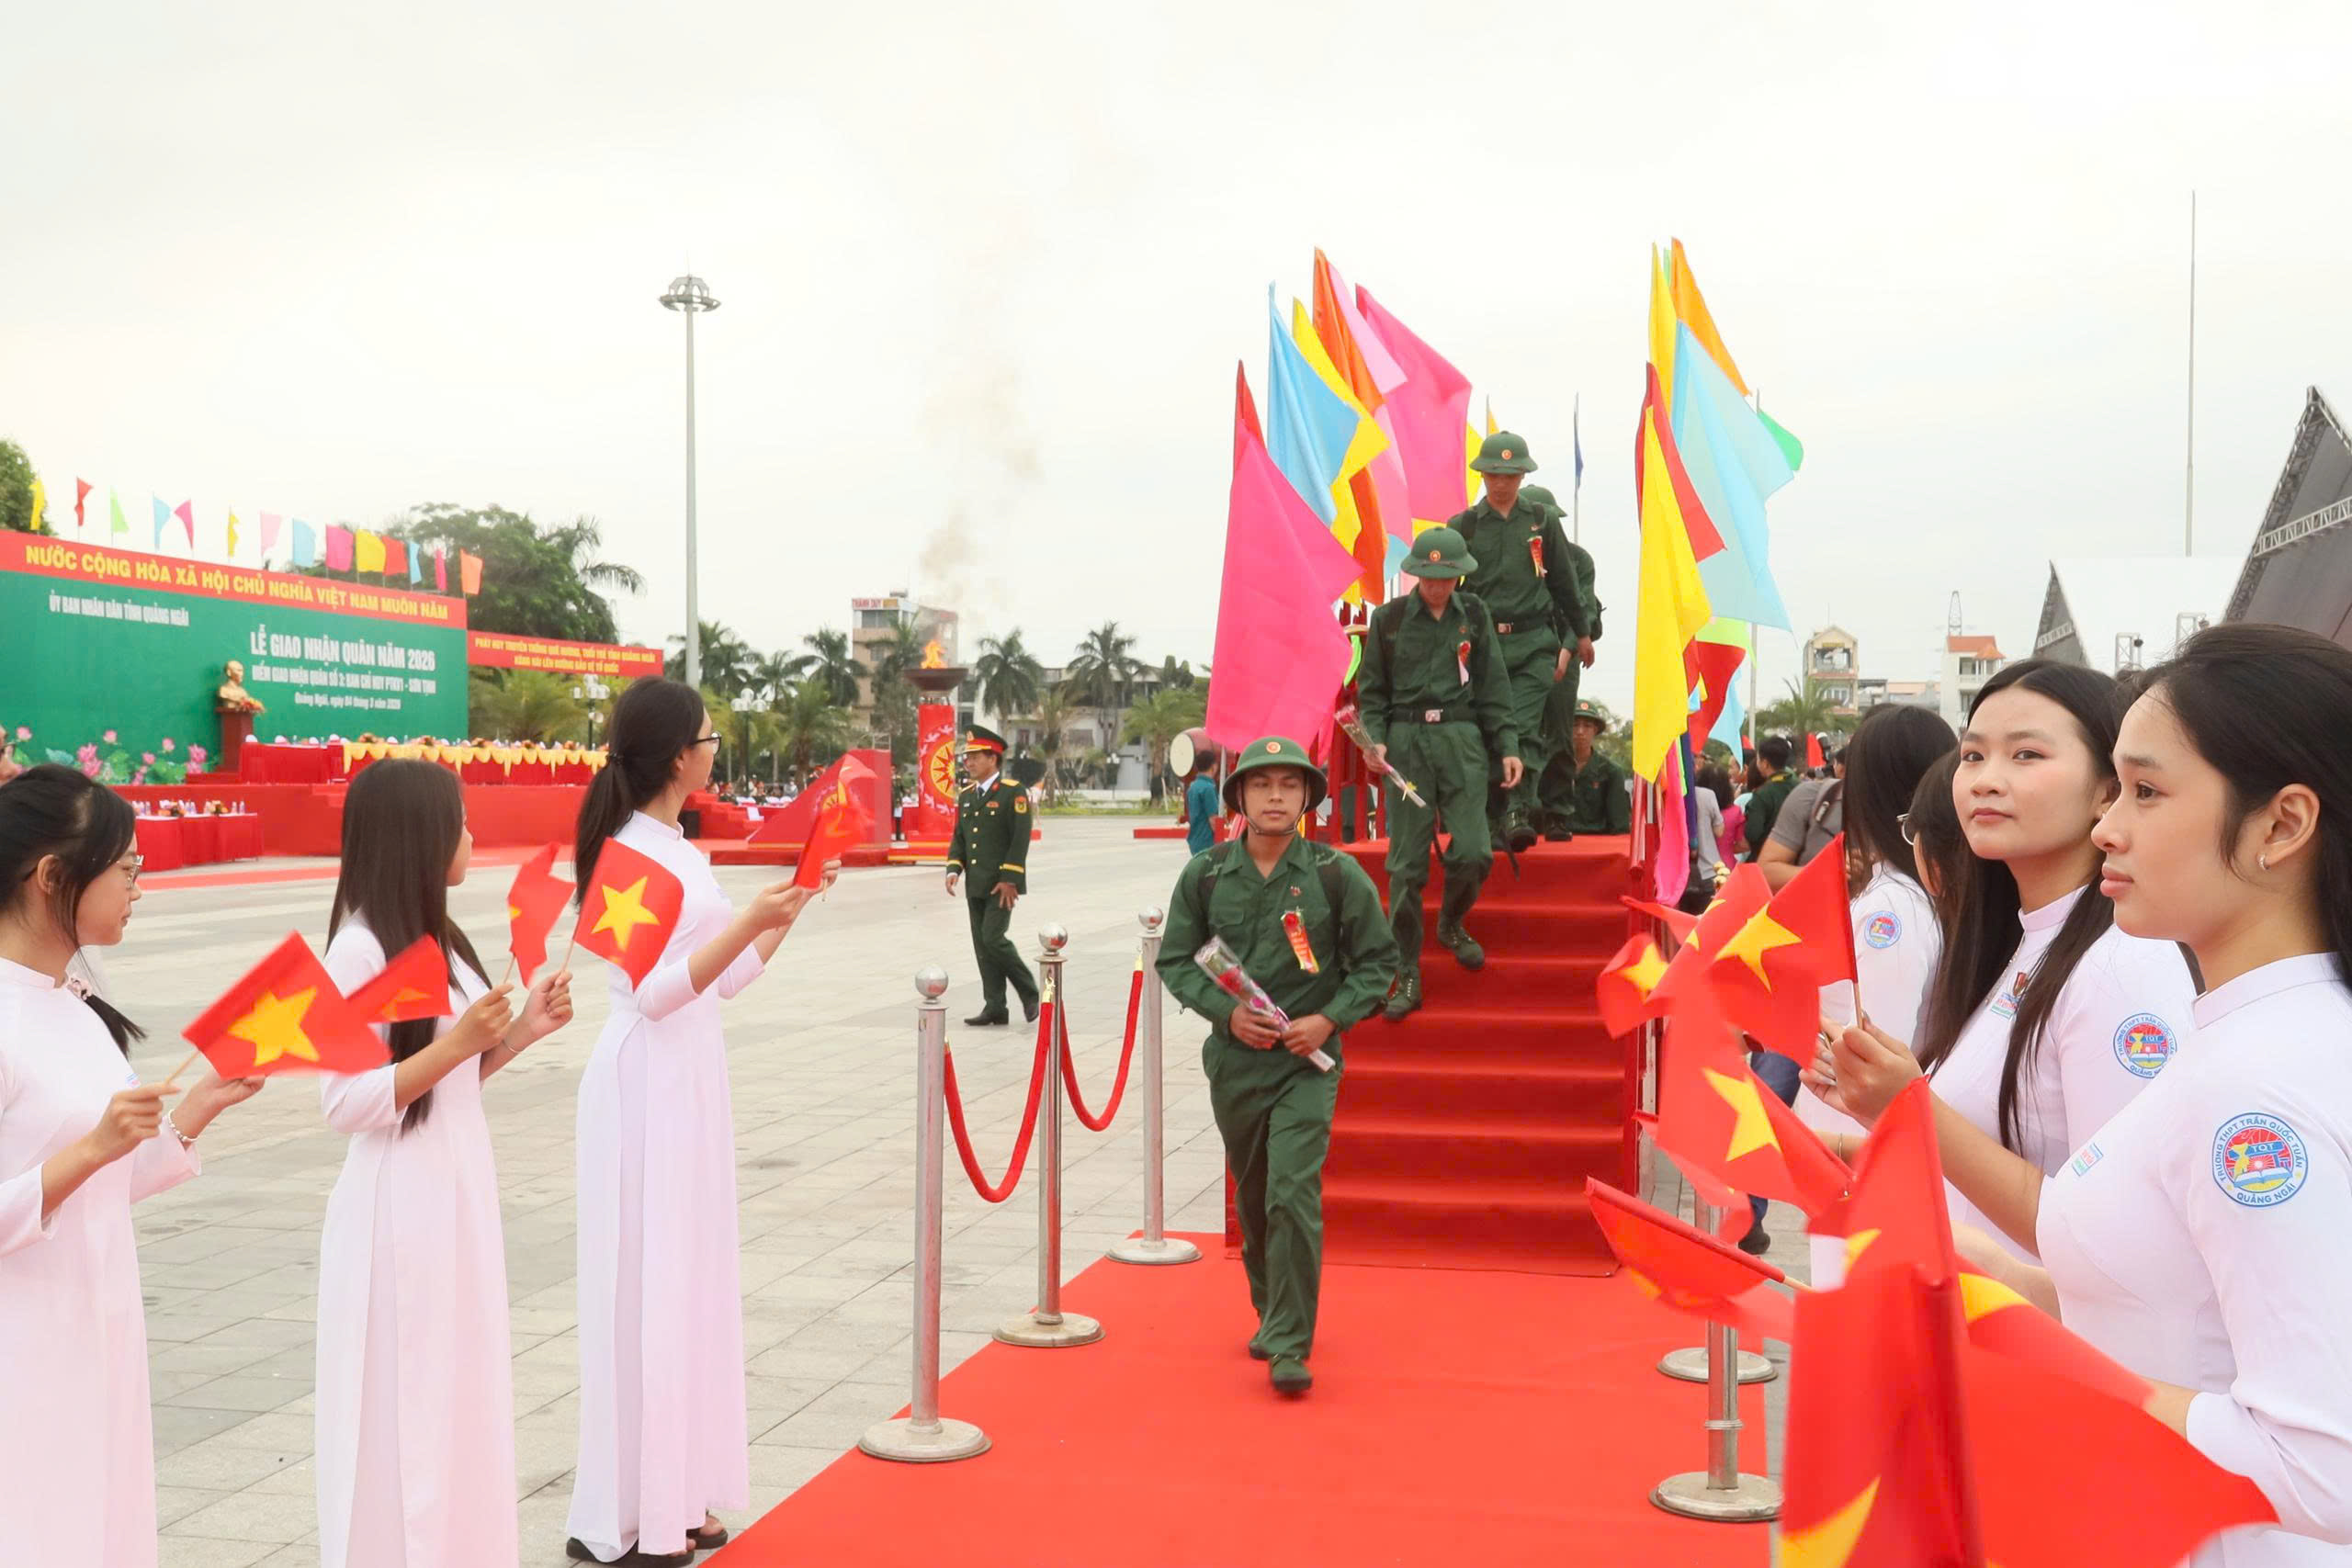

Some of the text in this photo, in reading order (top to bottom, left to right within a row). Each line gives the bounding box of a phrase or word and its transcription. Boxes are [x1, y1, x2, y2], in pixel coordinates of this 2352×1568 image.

[26, 546, 448, 620] NƯỚC CỘNG HÒA XÃ HỘI CHỦ NGHĨA VIỆT NAM MUÔN NĂM
[50, 590, 61, 613] ỦY
[62, 595, 80, 615] BAN
[81, 596, 105, 617] NHÂN
[106, 599, 123, 619] DÂN
[123, 599, 141, 621] TỈNH
[143, 603, 169, 624] QUẢNG
[250, 623, 435, 671] LỄ GIAO NHẬN QUÂN NĂM 2026
[289, 666, 309, 687] NHẬN
[2220, 1122, 2239, 1142] THPT
[2240, 1116, 2267, 1126] TRẦN
[2269, 1121, 2294, 1143] QUỐC
[2236, 1191, 2273, 1204] QUẢNG
